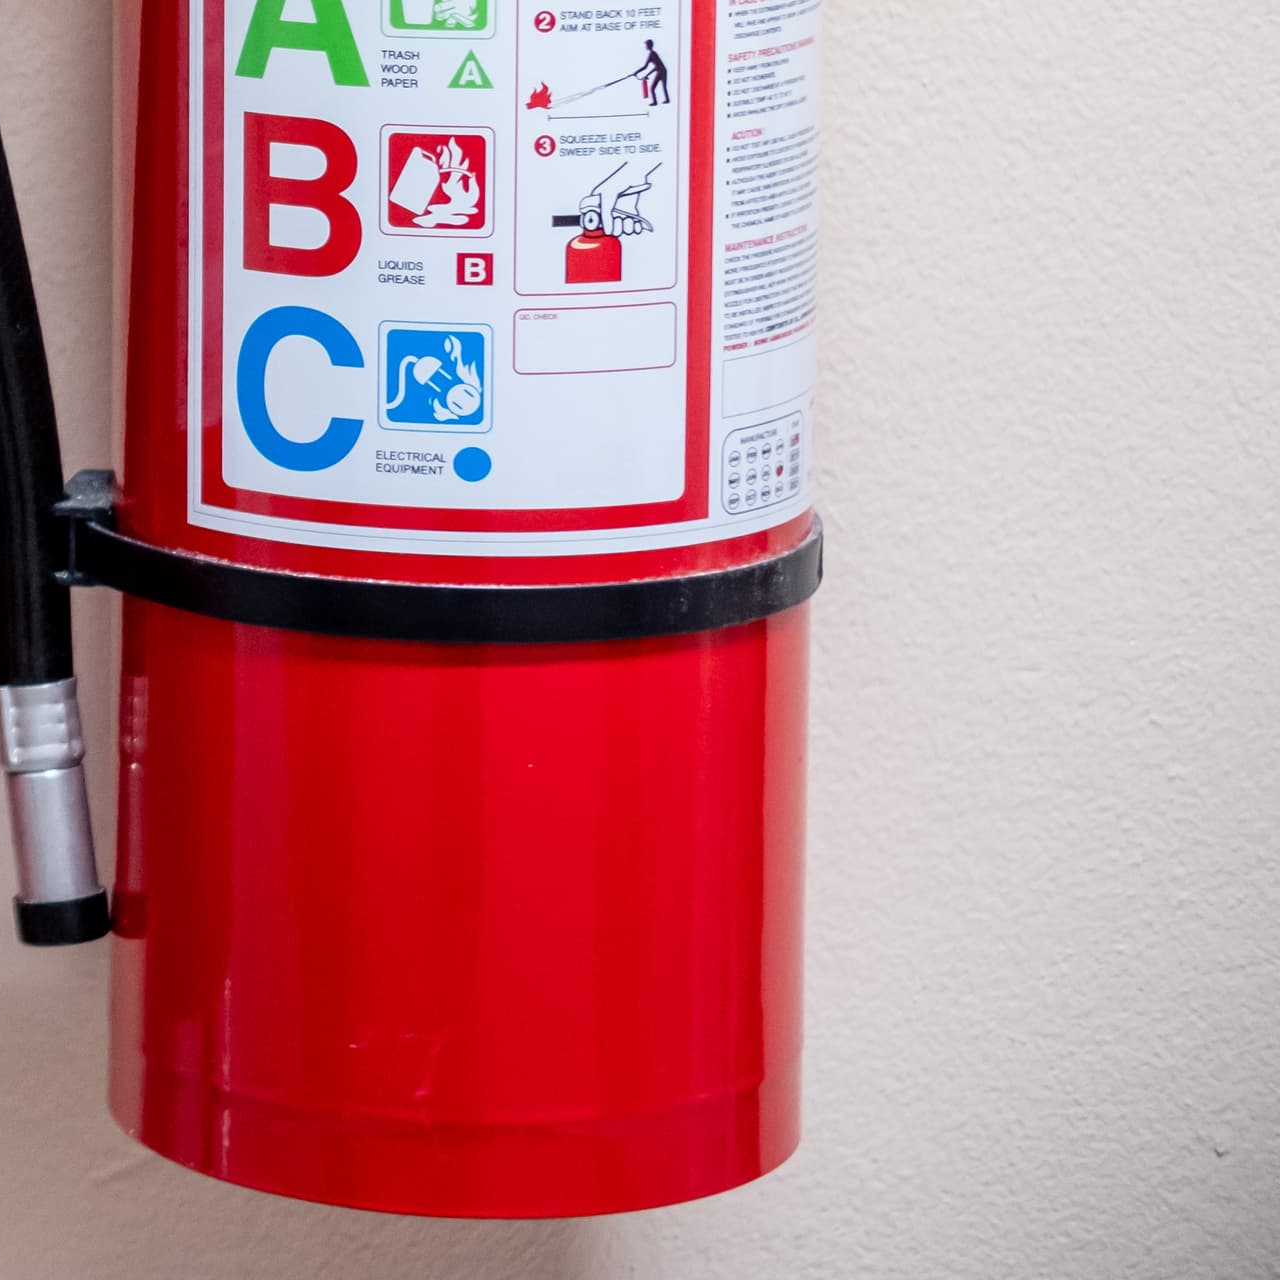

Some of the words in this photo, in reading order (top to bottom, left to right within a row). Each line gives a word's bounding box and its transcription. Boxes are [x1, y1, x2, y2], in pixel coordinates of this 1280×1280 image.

[560, 11, 593, 19] STAND
[596, 10, 622, 18] BACK
[626, 9, 635, 17] 10
[638, 7, 662, 16] FEET
[539, 14, 551, 29] 2
[560, 24, 578, 32] AIM
[582, 23, 592, 31] AT
[595, 23, 621, 31] BASE
[624, 22, 637, 30] OF
[381, 50, 420, 60] TRASH
[381, 64, 418, 74] WOOD
[458, 60, 483, 86] A
[381, 78, 418, 88] PAPER
[560, 134, 607, 144] SQUEEZE
[610, 133, 641, 142] LEVER
[539, 139, 551, 153] 3
[559, 148, 596, 156] SWEEP
[599, 147, 623, 155] SIDE
[624, 146, 636, 154] TO
[243, 111, 363, 278] B
[378, 259, 423, 271] LIQUIDS
[464, 257, 487, 283] B
[378, 274, 425, 285] GREASE
[236, 305, 364, 472] C
[375, 450, 446, 463] ELECTRICAL
[375, 463, 445, 475] EQUIPMENT
